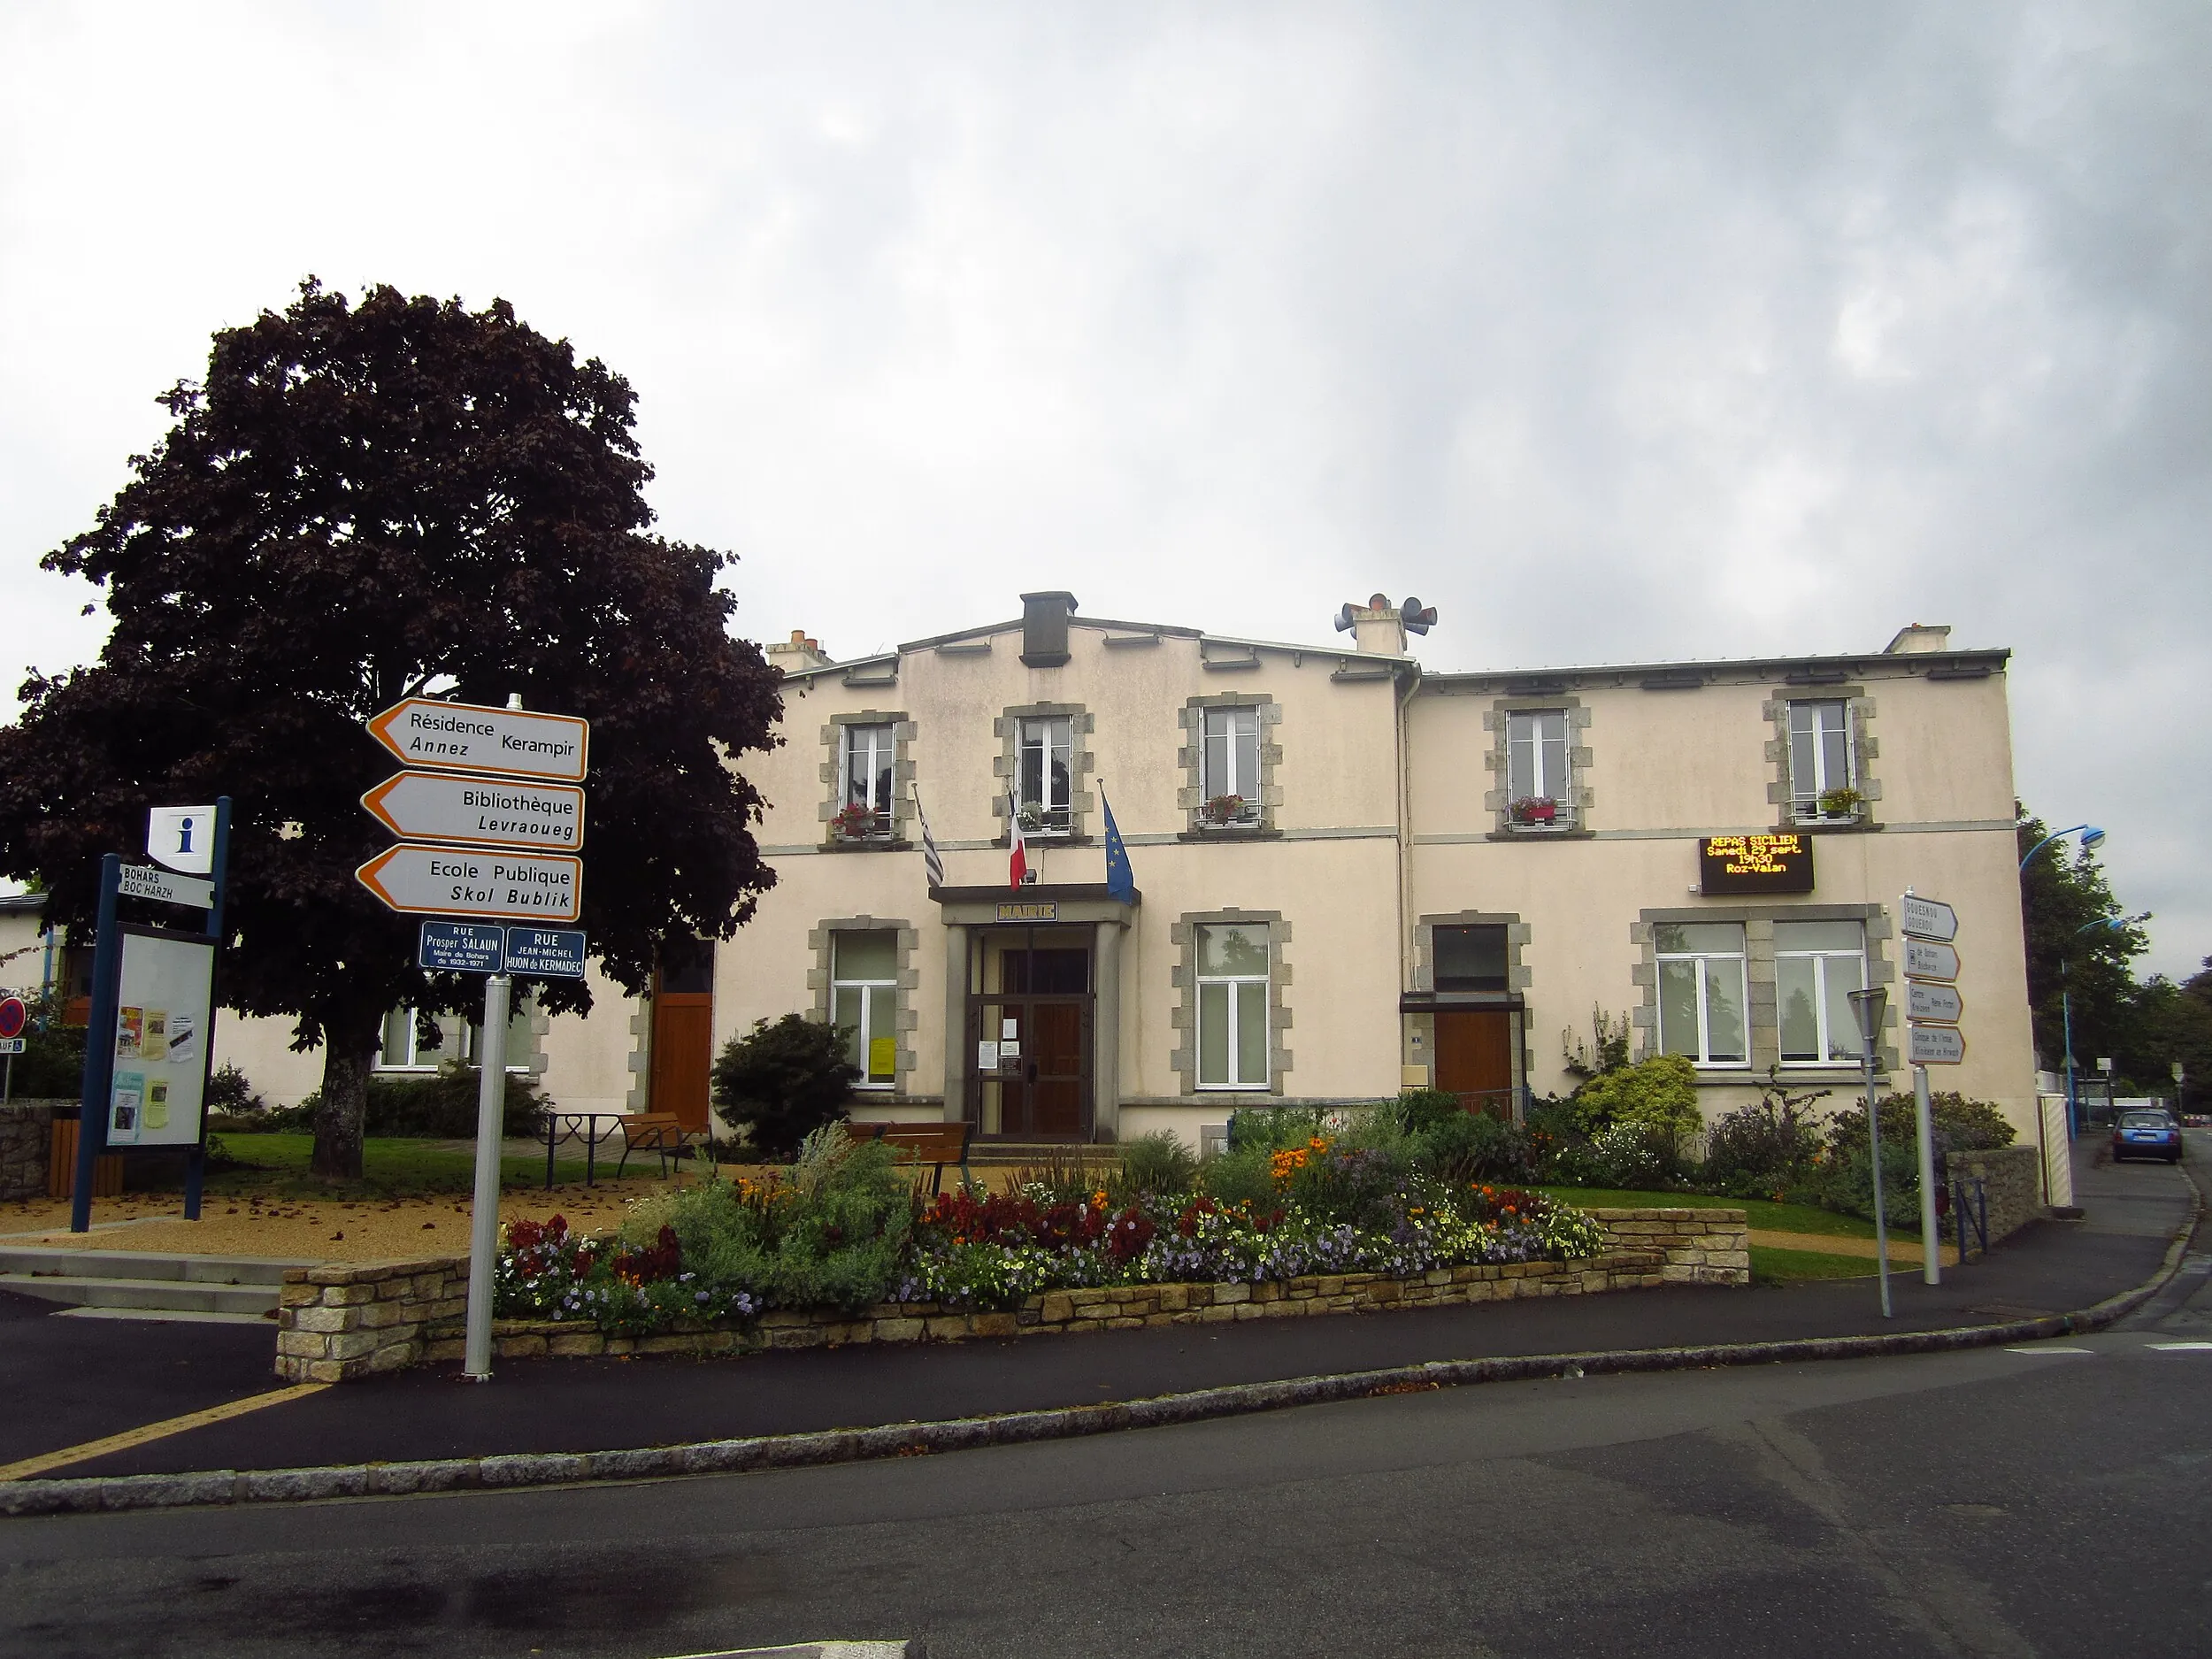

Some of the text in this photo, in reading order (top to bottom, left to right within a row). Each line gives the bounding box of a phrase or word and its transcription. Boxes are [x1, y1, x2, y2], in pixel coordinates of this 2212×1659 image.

[410, 712, 495, 736] Résidence
[410, 737, 469, 756] Annez
[502, 734, 575, 758] Kerampir
[463, 791, 573, 816] Bibliothèque
[478, 816, 573, 840] Levraoueg
[1711, 834, 1798, 847] REPAS SICILIEN
[1707, 844, 1801, 856] Samedi 29 sept.
[1739, 854, 1772, 864] 19h30
[125, 868, 159, 884] BOHARS
[430, 861, 571, 887] Ecole Publique
[1726, 863, 1786, 873] Roz-Valan
[124, 880, 173, 899] BOC'HARZH
[450, 886, 570, 908] Skol Bublik
[998, 904, 1055, 919] MAIRIE
[453, 926, 474, 936] RUE
[426, 934, 498, 951] Prosper SALAUN
[534, 933, 559, 947] RUE
[465, 951, 489, 960] Bohars
[517, 946, 573, 958] JEAN-MICHEL
[449, 958, 484, 967] 1932-1971
[506, 956, 582, 973] HUON de KERMADEC
